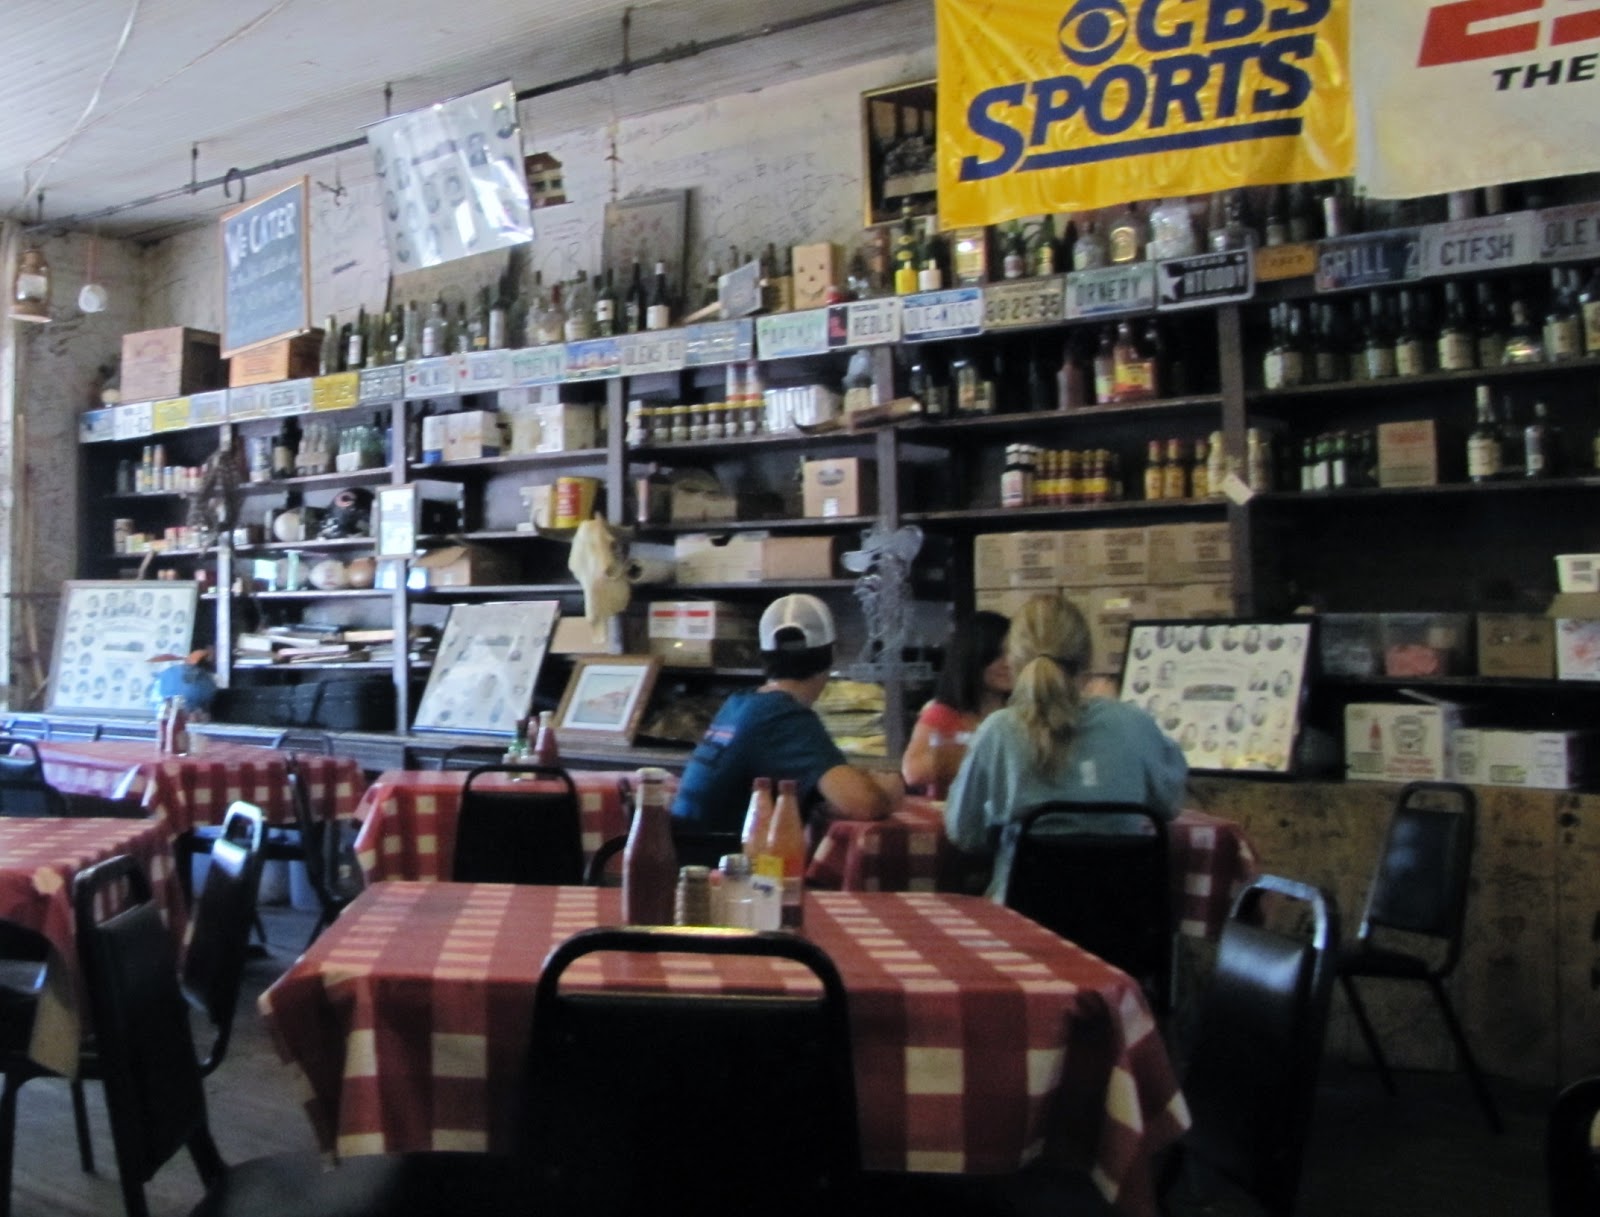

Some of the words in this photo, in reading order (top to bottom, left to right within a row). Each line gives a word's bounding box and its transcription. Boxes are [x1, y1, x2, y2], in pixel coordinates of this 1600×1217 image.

[1492, 52, 1599, 91] THE
[958, 33, 1315, 182] SPORTS
[249, 202, 297, 254] CATER
